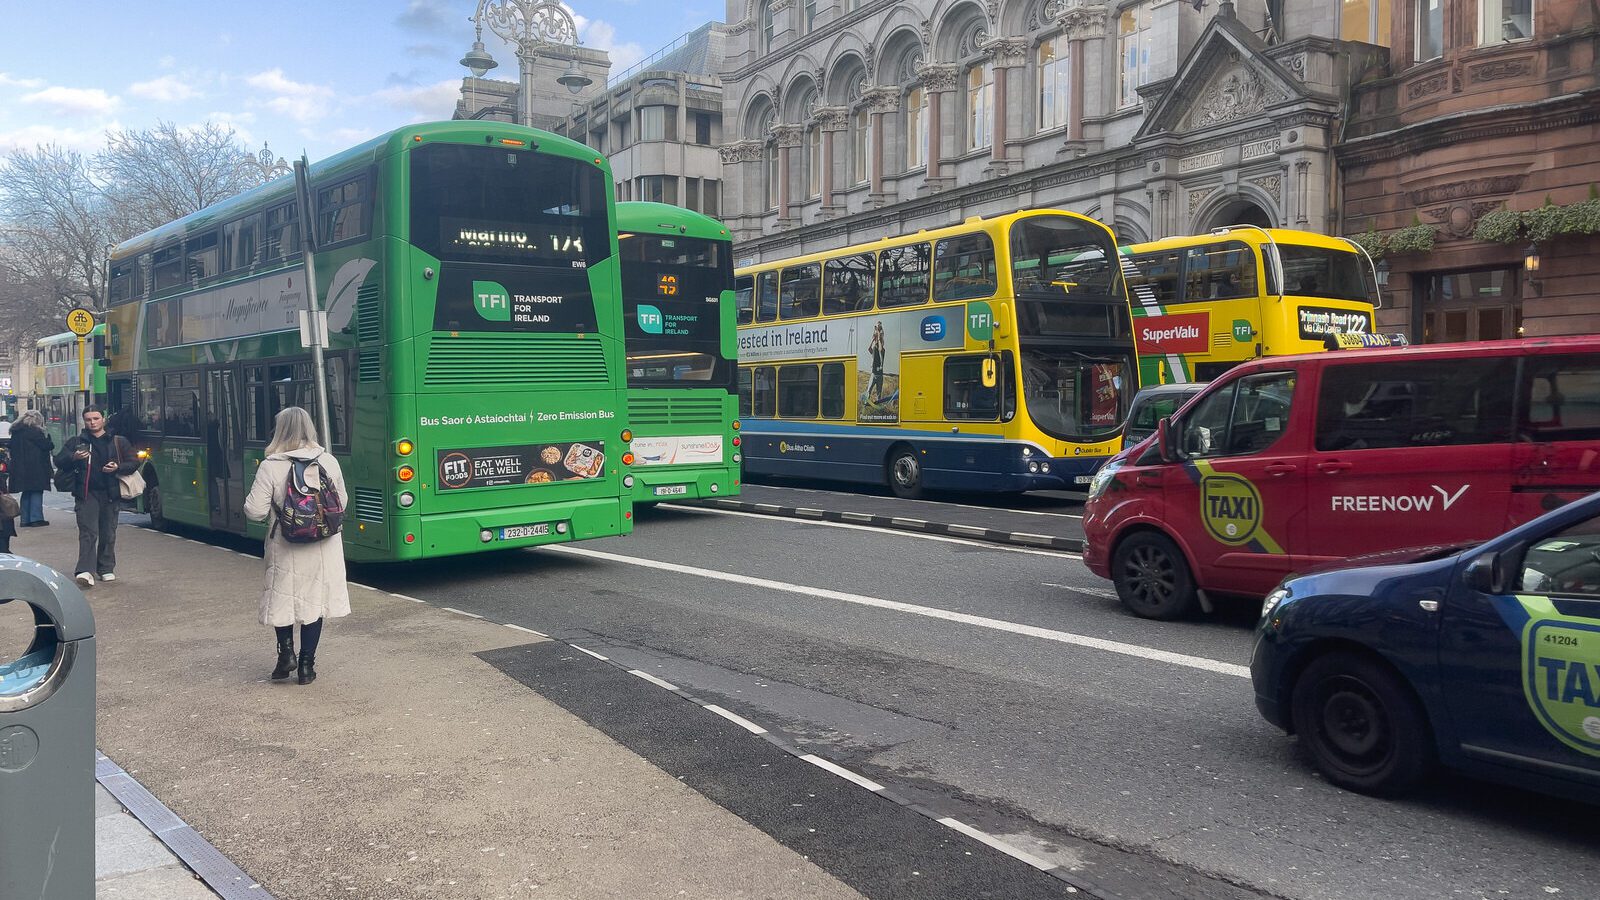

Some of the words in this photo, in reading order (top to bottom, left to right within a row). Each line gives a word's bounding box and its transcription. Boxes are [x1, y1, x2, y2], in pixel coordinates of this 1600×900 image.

[478, 294, 506, 308] TFI
[514, 294, 562, 304] TRANSPORT
[514, 314, 550, 322] IRELAND
[641, 314, 660, 325] TFI
[970, 314, 990, 328] TFI
[1347, 314, 1366, 334] 122
[925, 323, 941, 334] ESB
[1143, 326, 1199, 343] SuperValu
[1235, 326, 1251, 335] TFI
[771, 330, 782, 346] in
[786, 325, 828, 345] Ireland
[1362, 334, 1386, 346] TAXI
[420, 416, 439, 426] Bus
[442, 416, 464, 425] Saor
[466, 415, 471, 424] ó
[537, 412, 557, 421] Zero
[559, 410, 597, 420] Emission
[599, 410, 614, 419] Bus
[444, 459, 467, 474] FIT
[474, 460, 493, 468] EAT
[495, 458, 521, 467] WELL
[446, 472, 468, 481] FOODS
[474, 468, 493, 476] LIVE
[495, 466, 521, 475] WELL
[1208, 495, 1252, 520] TAXI
[1332, 496, 1434, 512] FREENOW
[508, 525, 549, 538] 232-D-24415
[1544, 634, 1578, 646] 41204
